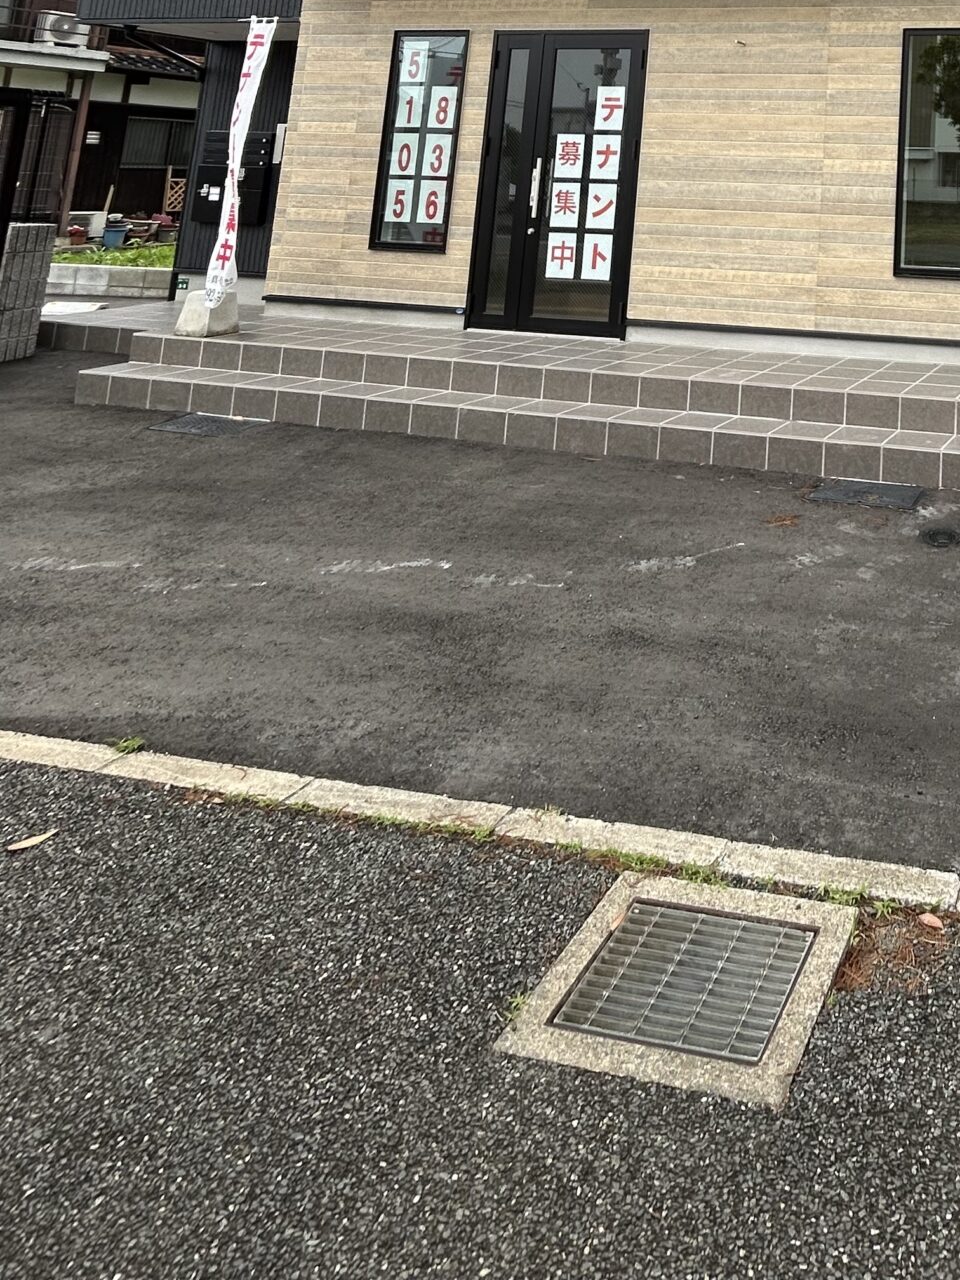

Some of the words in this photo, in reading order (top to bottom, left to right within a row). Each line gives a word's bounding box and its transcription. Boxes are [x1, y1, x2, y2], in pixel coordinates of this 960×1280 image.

[550, 140, 582, 270] 募集中
[591, 96, 624, 270] テナント
